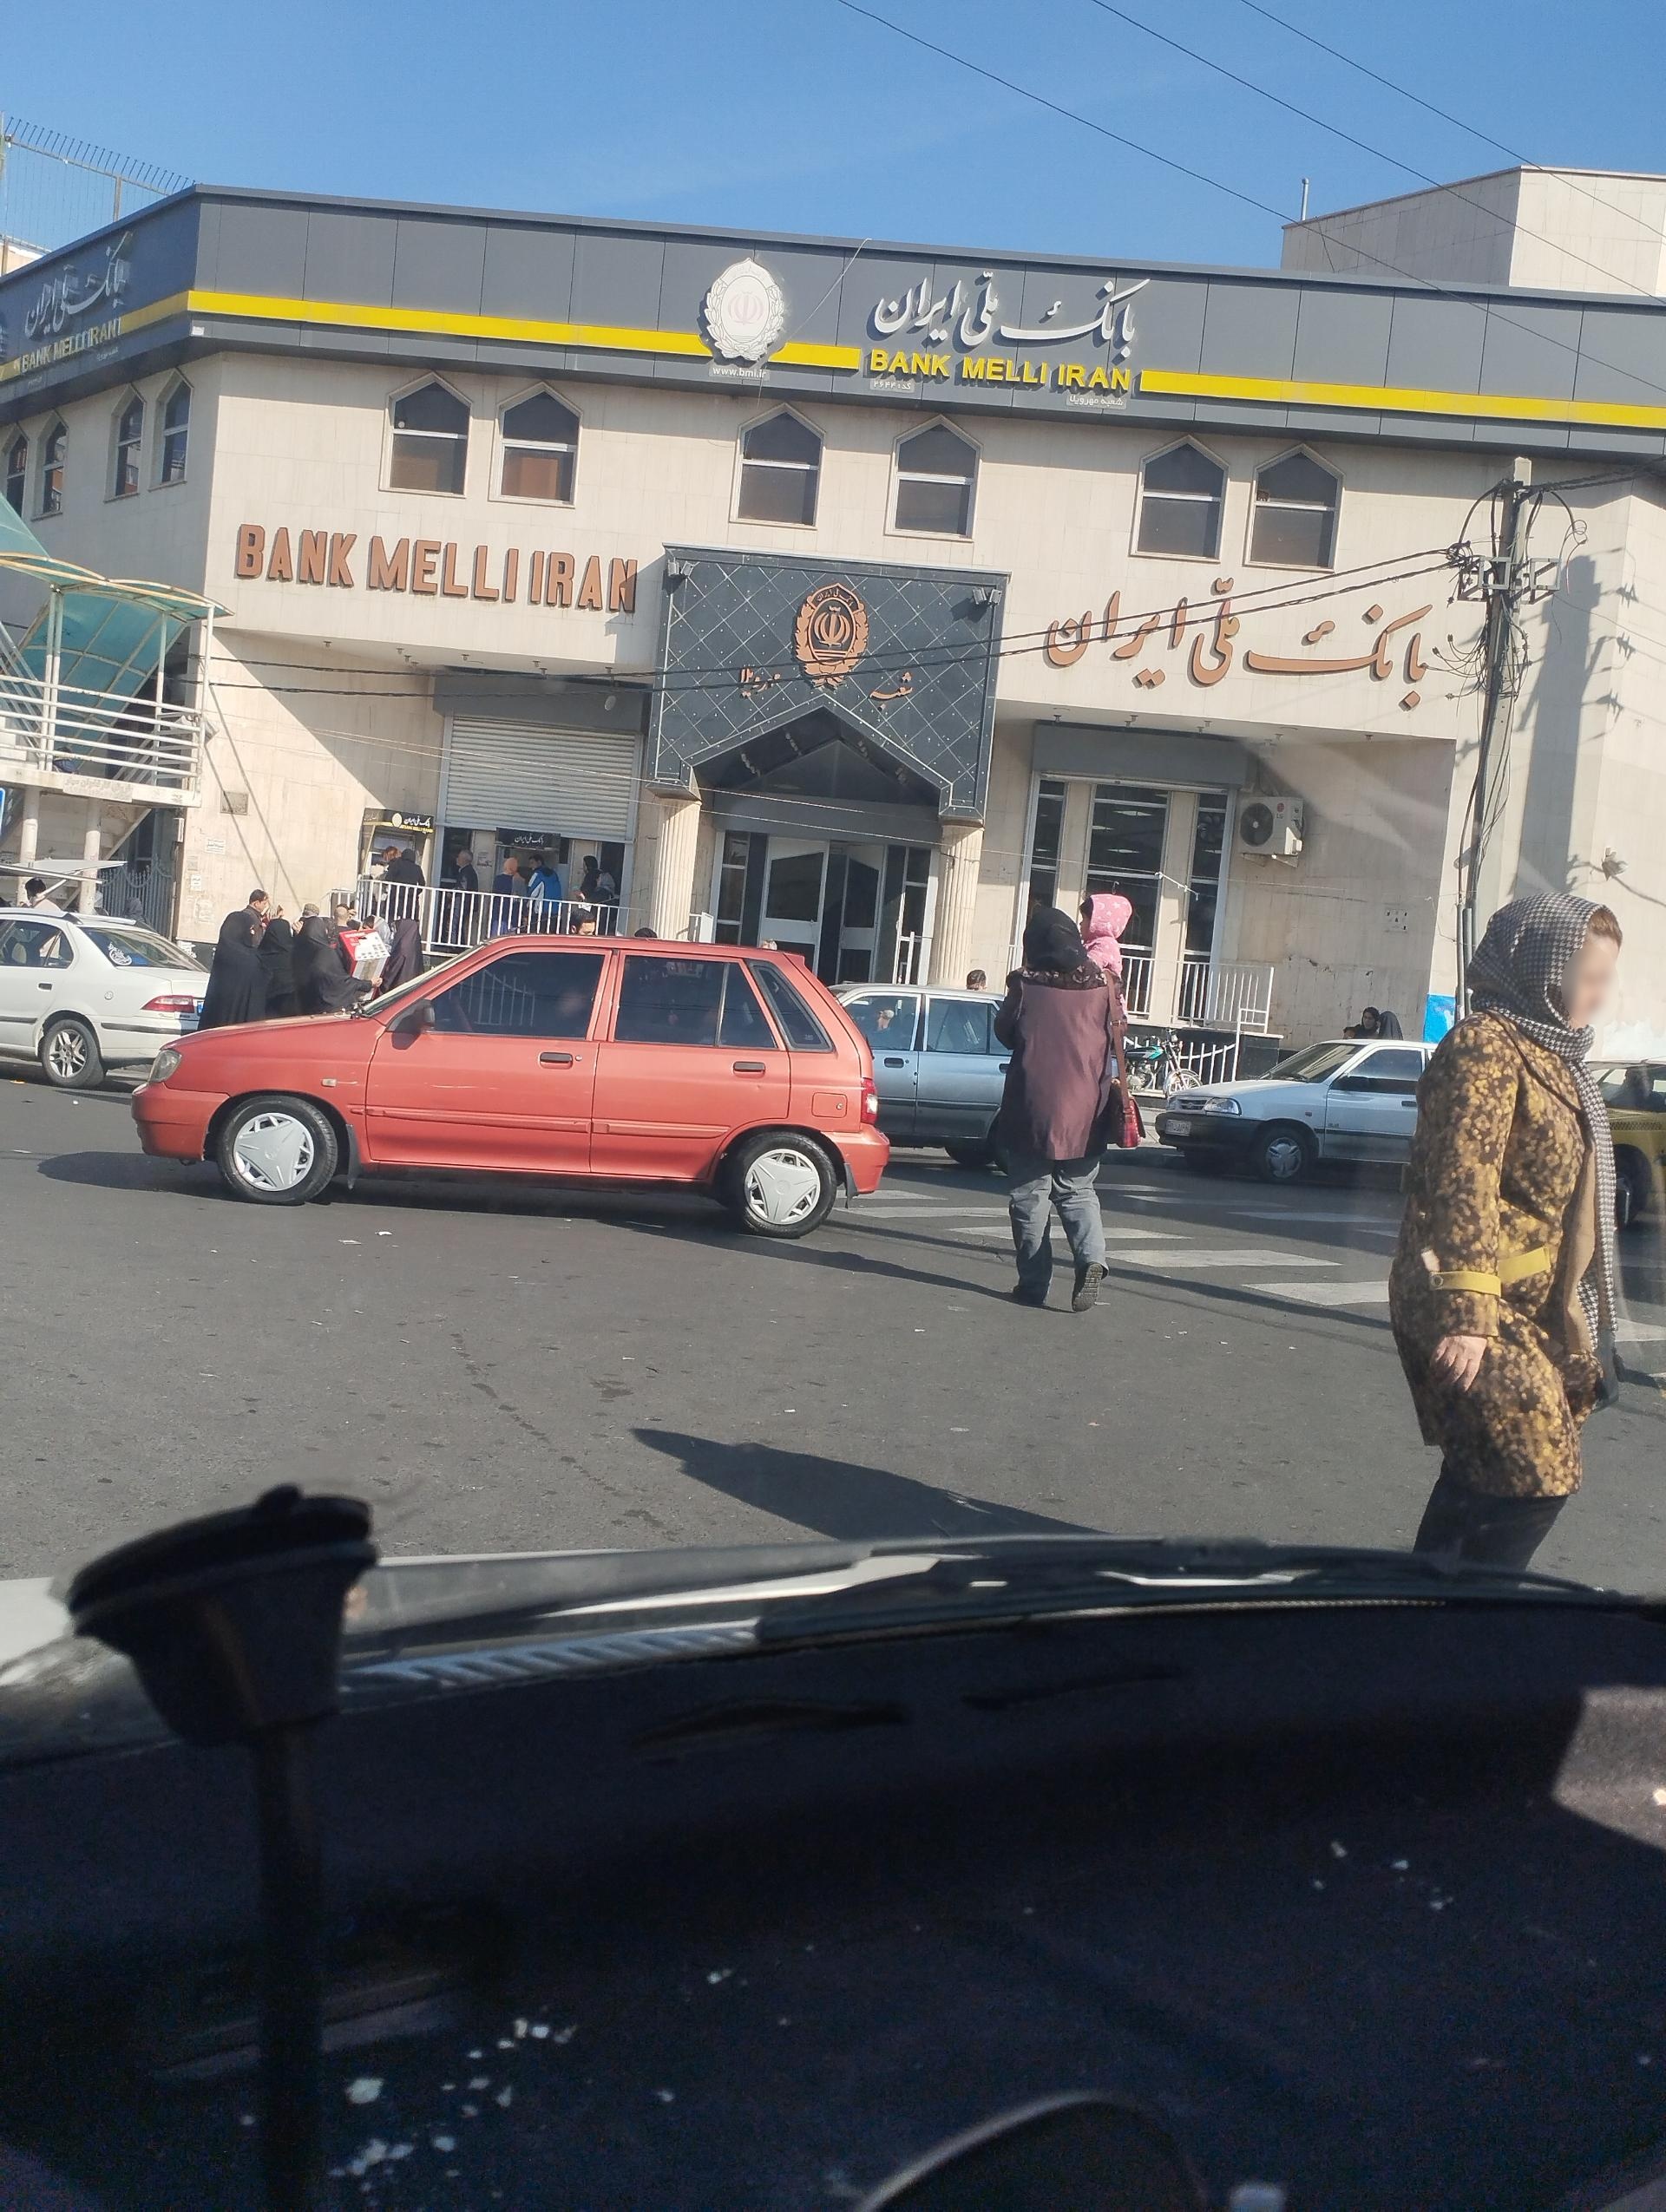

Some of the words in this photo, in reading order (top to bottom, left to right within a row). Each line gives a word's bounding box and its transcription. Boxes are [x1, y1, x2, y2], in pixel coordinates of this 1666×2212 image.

[875, 278, 962, 341] ایران
[1000, 278, 1151, 358] بانک
[712, 367, 767, 378] www.bmi.ir
[870, 349, 952, 376] BANK
[962, 356, 1048, 384] MELLI
[1058, 363, 1131, 390] IRAN
[1100, 397, 1124, 407] شعبه
[236, 523, 358, 587] BANK
[368, 535, 521, 602] MELLI
[530, 550, 639, 612] IRAN
[1047, 590, 1188, 689] ایران
[1247, 604, 1433, 710] بانک
